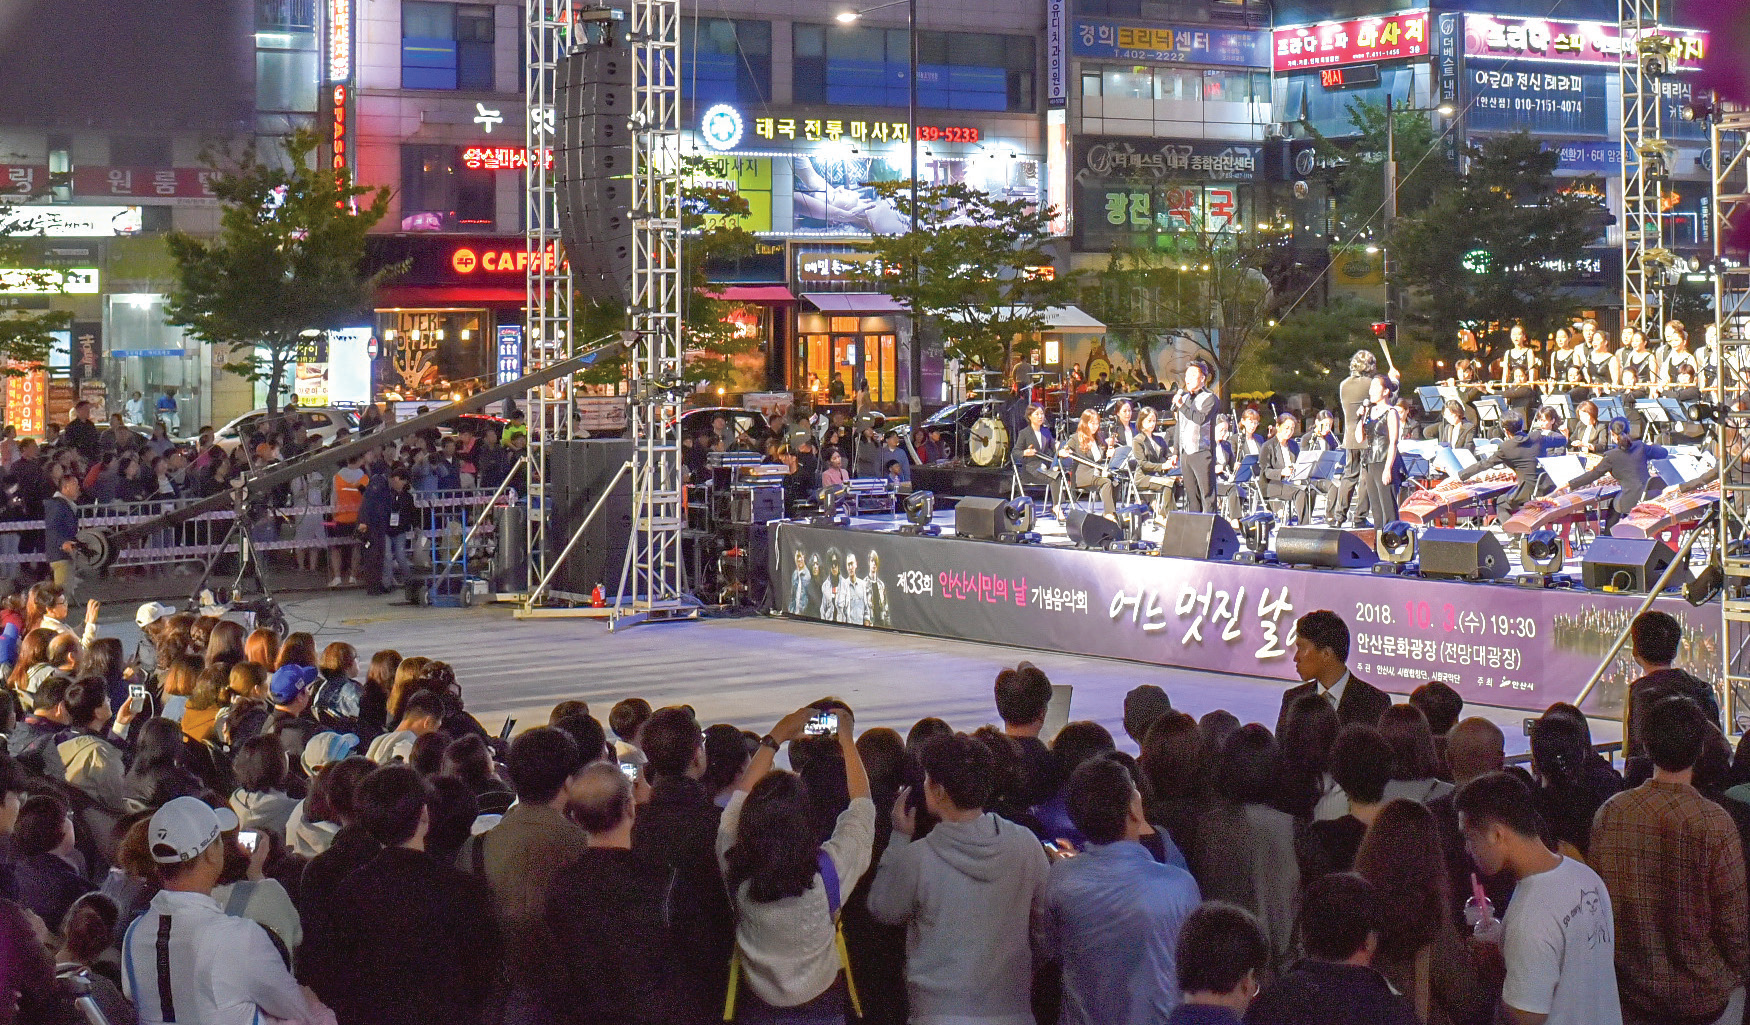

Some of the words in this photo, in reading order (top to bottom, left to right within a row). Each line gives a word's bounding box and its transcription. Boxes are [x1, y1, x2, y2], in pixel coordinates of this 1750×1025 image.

[1079, 25, 1114, 47] 경희
[1175, 32, 1210, 52] 센터
[1357, 17, 1425, 48] 마사지
[1475, 70, 1513, 89] 아로마
[1516, 72, 1541, 91] 전신
[1544, 74, 1582, 92] 테라피
[1514, 97, 1582, 113] 010-7151-4074
[756, 117, 796, 141] 태국
[804, 119, 844, 142] 전통
[851, 121, 909, 143] 마사지
[1105, 192, 1152, 225] 광진
[1167, 188, 1234, 226] 약국
[897, 570, 933, 597] 제33회
[938, 569, 1008, 603] 안산시민의
[1012, 577, 1028, 607] 날
[1031, 585, 1089, 615] 기념음악회
[1109, 585, 1166, 631] 어느
[1175, 582, 1245, 645] 멋진
[1255, 586, 1298, 659] 날
[1355, 602, 1396, 625] 2018.
[1405, 600, 1434, 630] 10.
[1490, 615, 1536, 638] 19:30
[1357, 633, 1437, 662] 안산문화광장
[1440, 640, 1521, 671] (전망대광장)
[1511, 680, 1534, 691] 안산시
